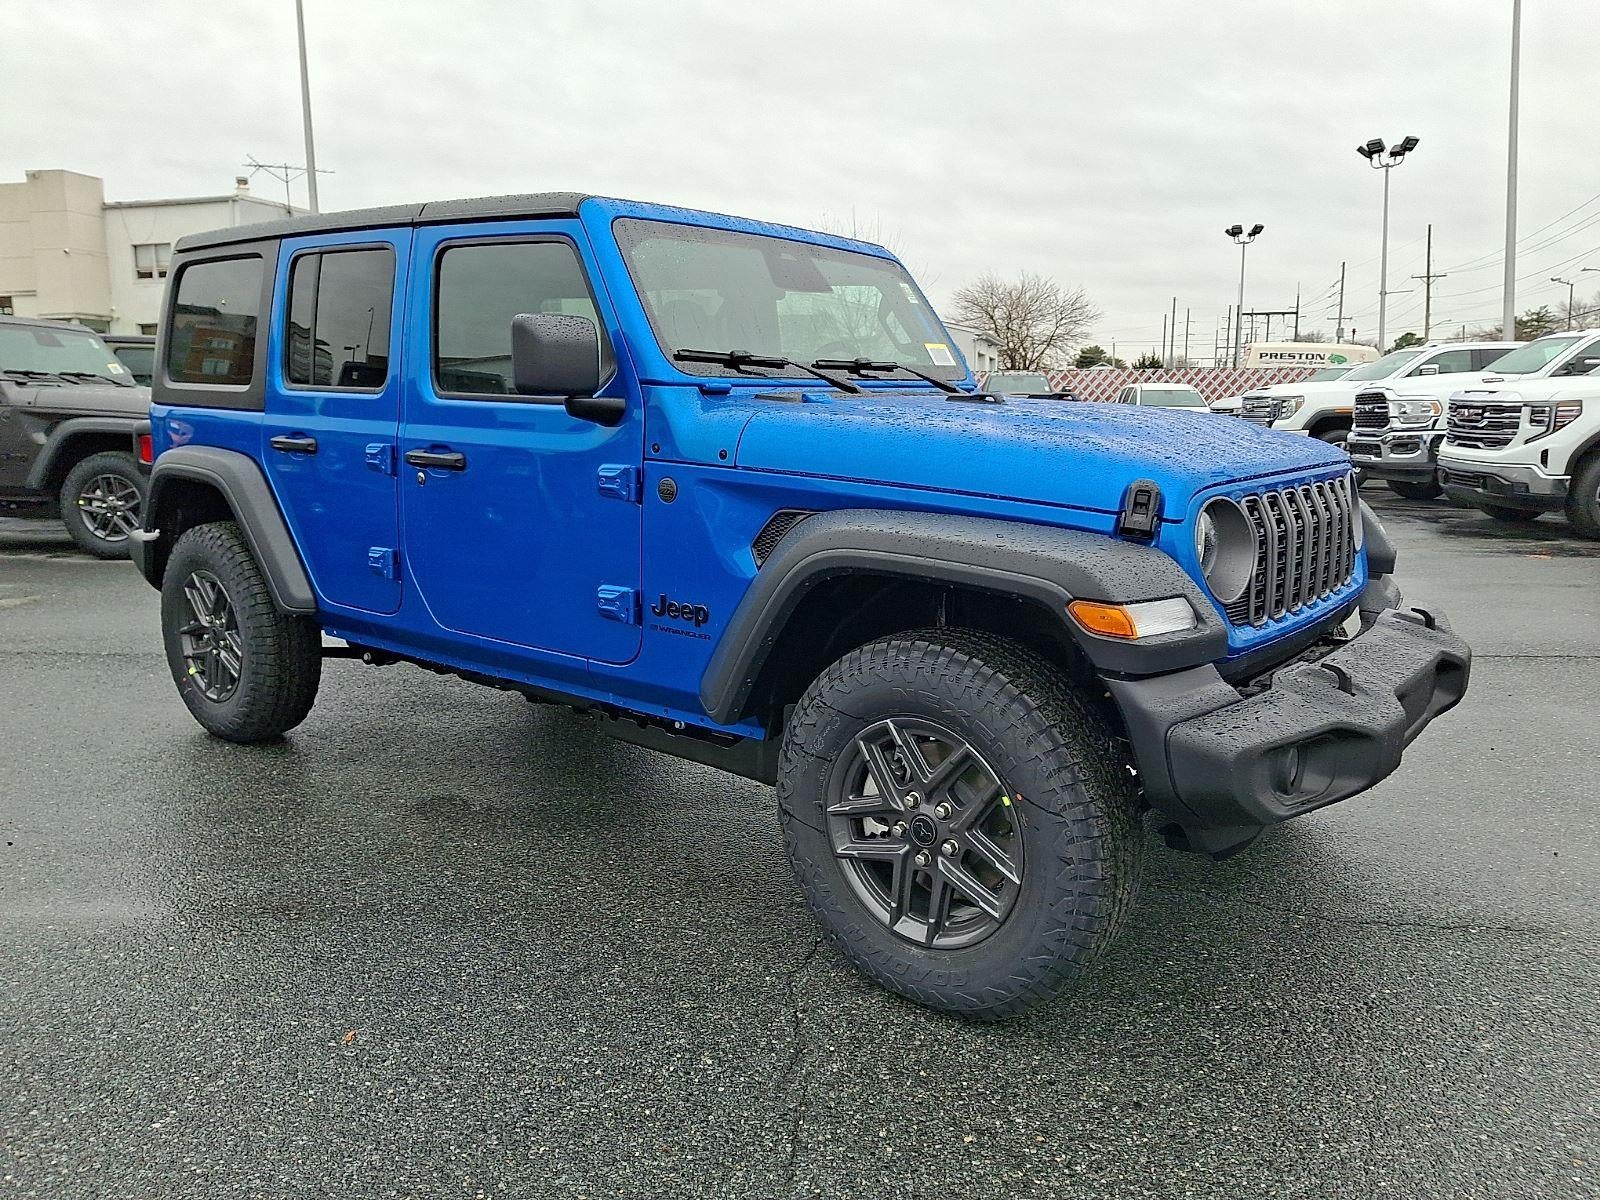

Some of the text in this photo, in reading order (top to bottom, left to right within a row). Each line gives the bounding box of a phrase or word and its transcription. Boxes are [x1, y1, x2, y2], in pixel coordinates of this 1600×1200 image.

[1259, 352, 1326, 360] PRESTON
[651, 593, 709, 628] Jeep
[660, 626, 711, 641] WRANGLER
[891, 686, 1018, 774] NEXEN
